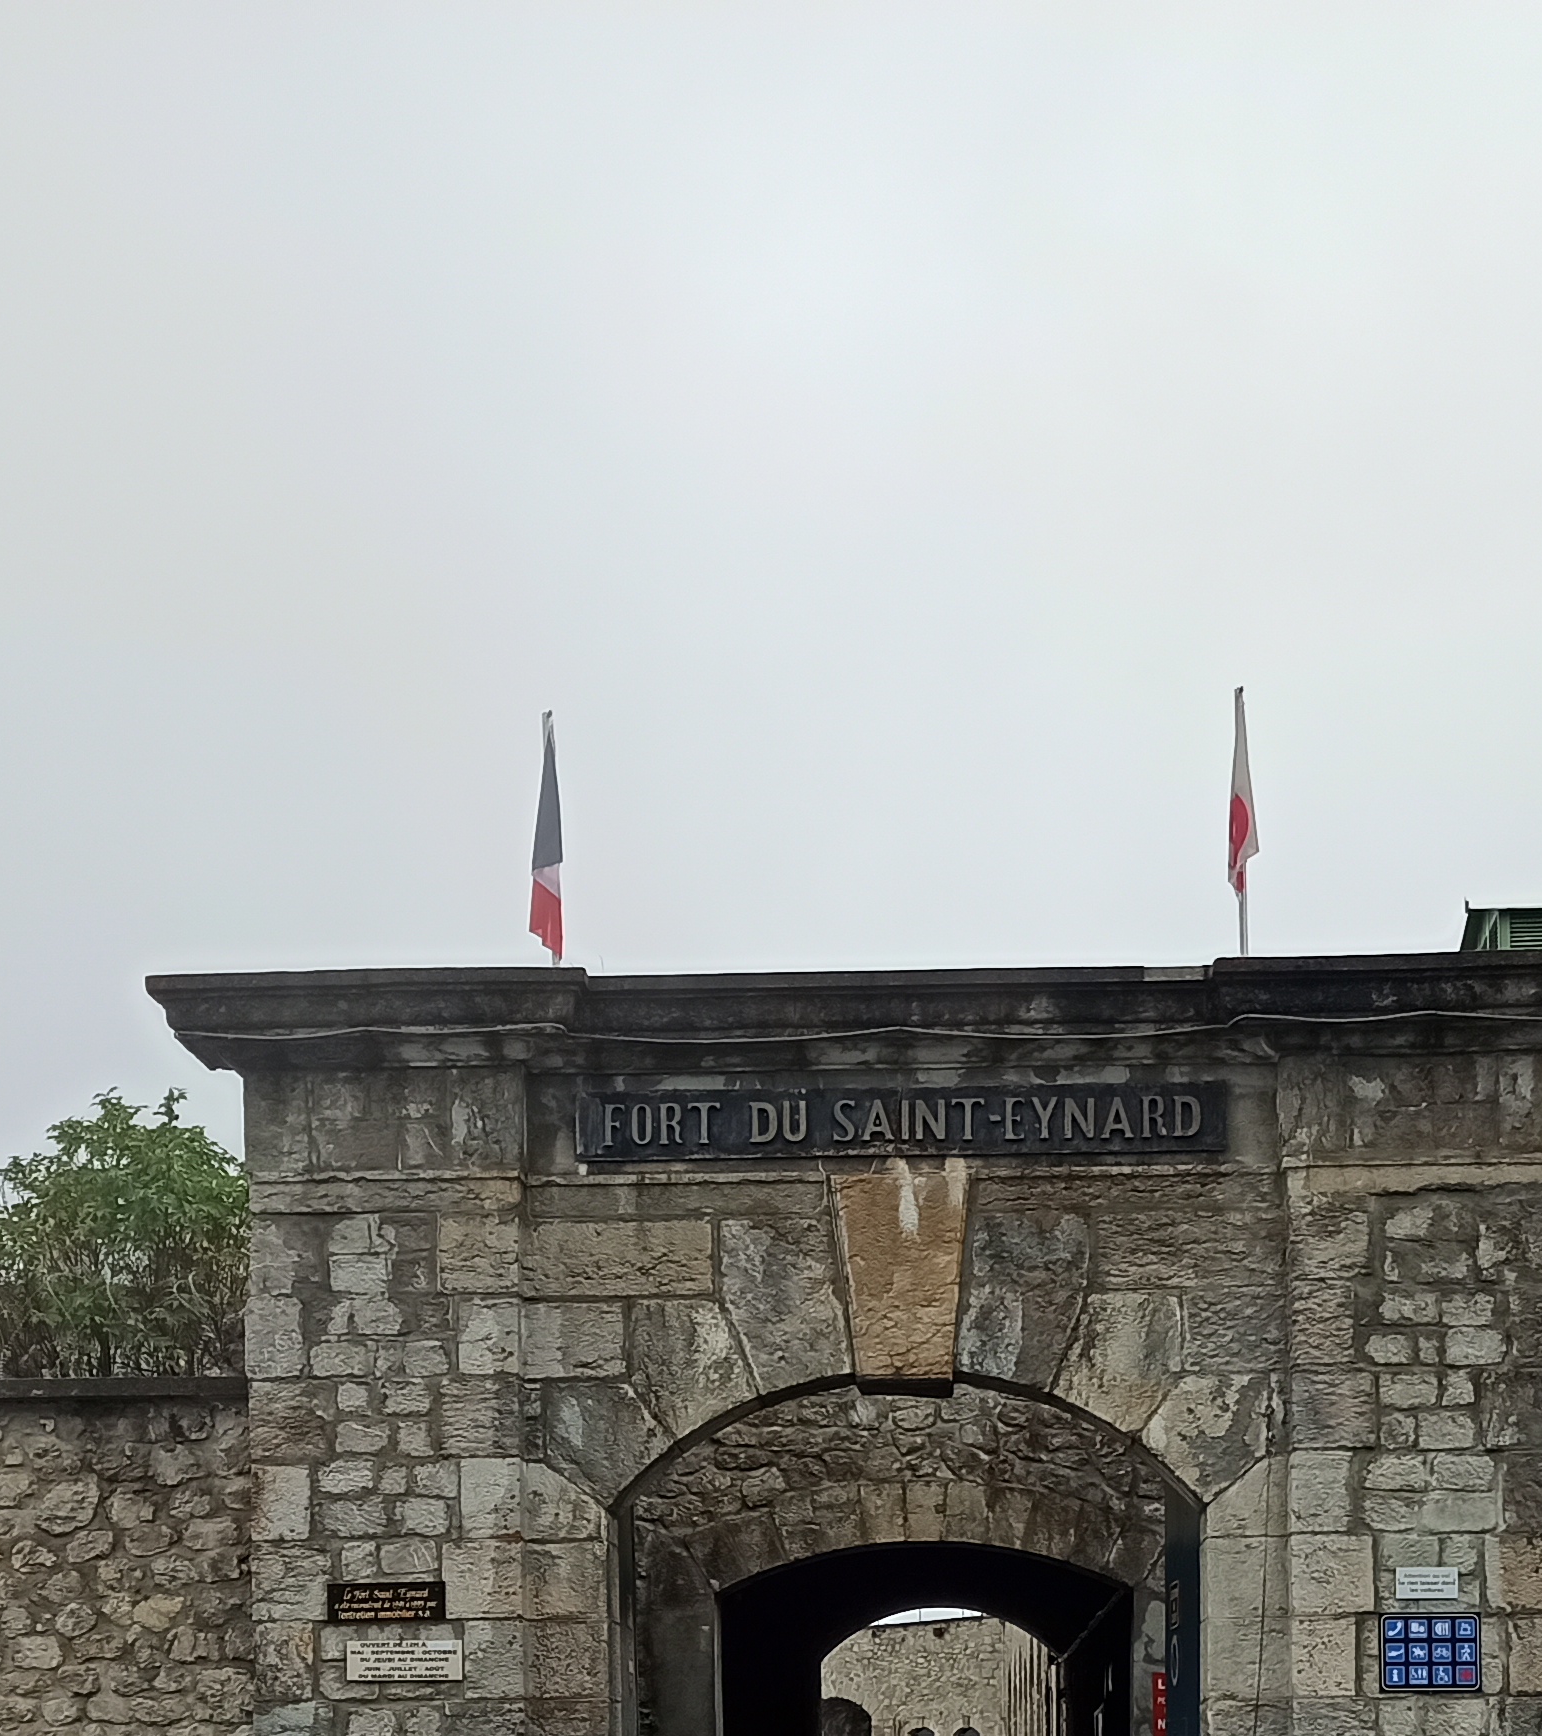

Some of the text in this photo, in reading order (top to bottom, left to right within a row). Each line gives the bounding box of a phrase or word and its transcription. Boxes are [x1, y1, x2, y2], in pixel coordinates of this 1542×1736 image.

[601, 1095, 1202, 1147] FORT DU SAINT-EYNARD
